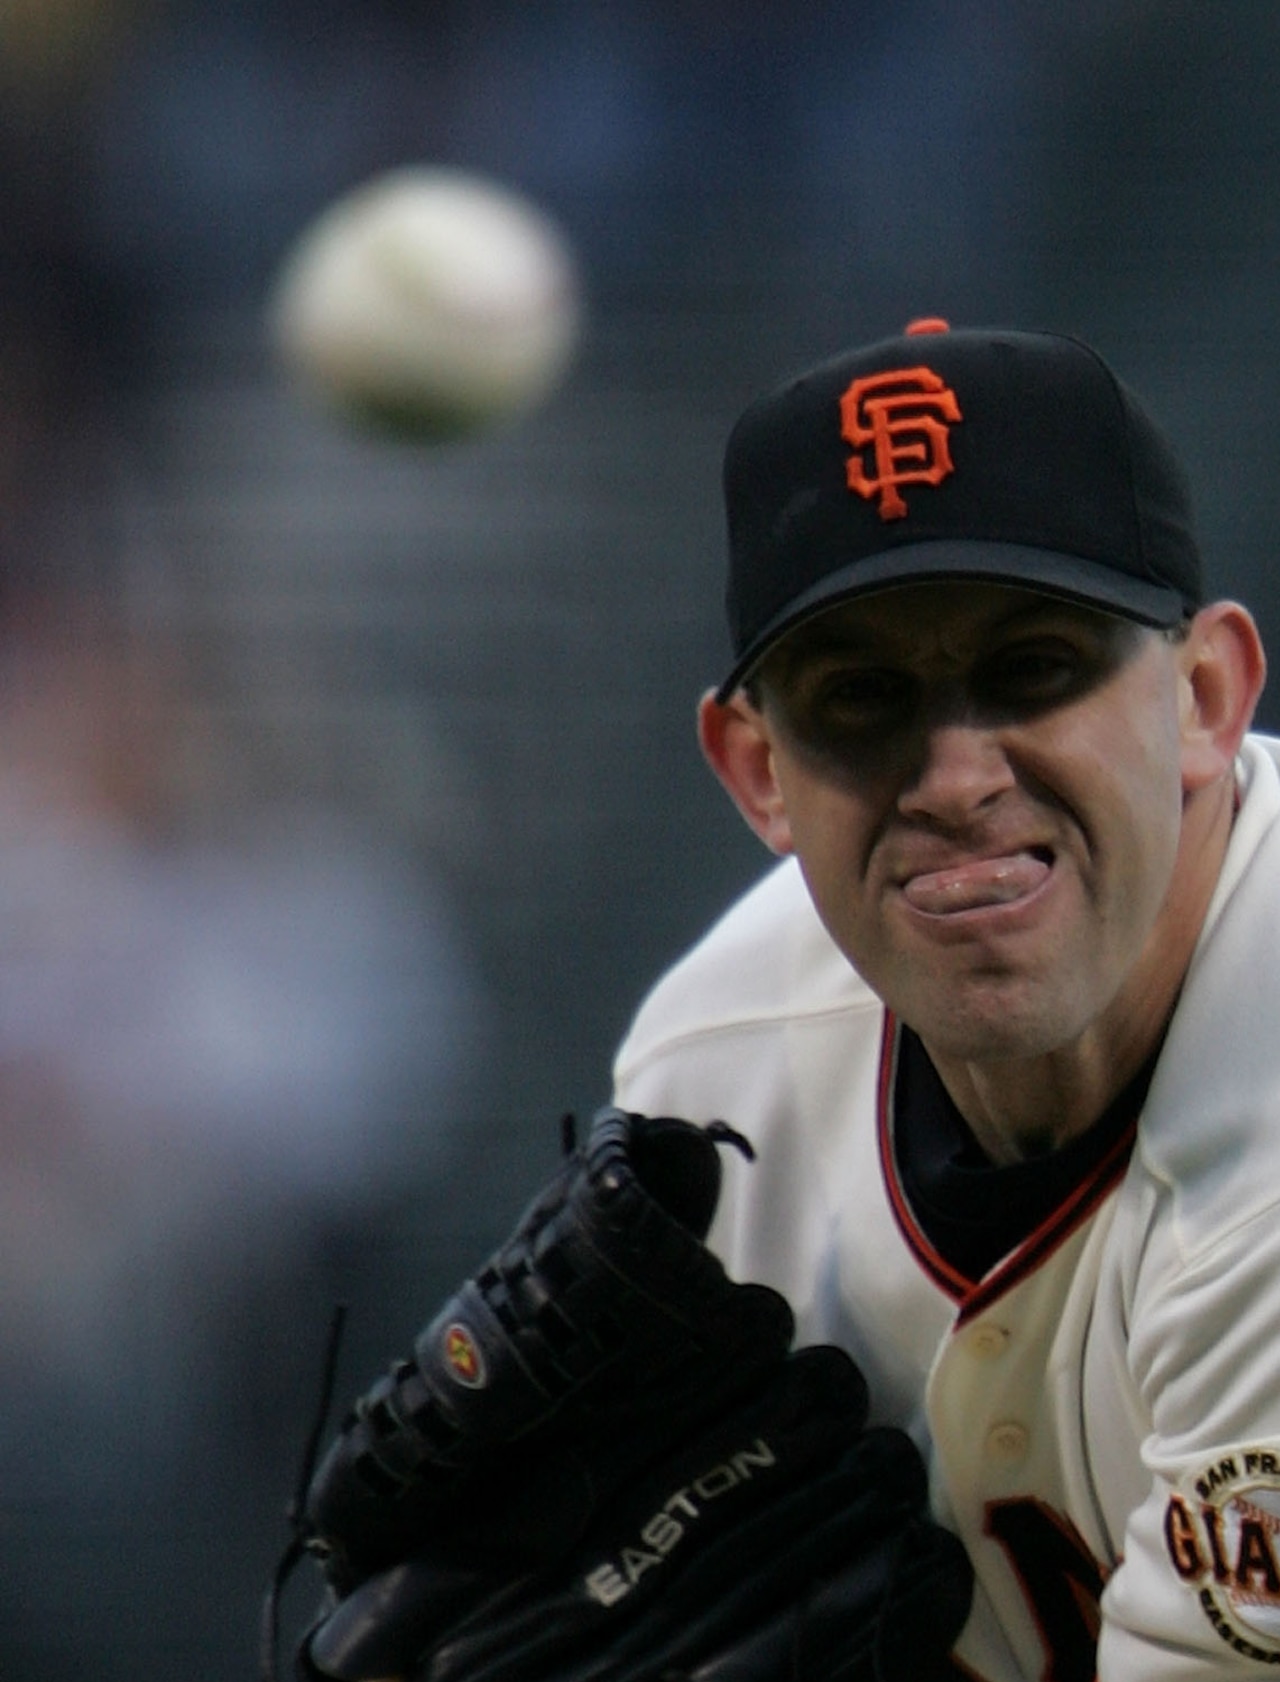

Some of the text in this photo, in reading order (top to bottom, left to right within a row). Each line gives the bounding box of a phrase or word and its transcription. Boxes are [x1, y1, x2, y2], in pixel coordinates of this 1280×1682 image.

[839, 364, 962, 521] SF
[584, 1437, 776, 1607] EASTON
[1195, 1457, 1238, 1498] SAN
